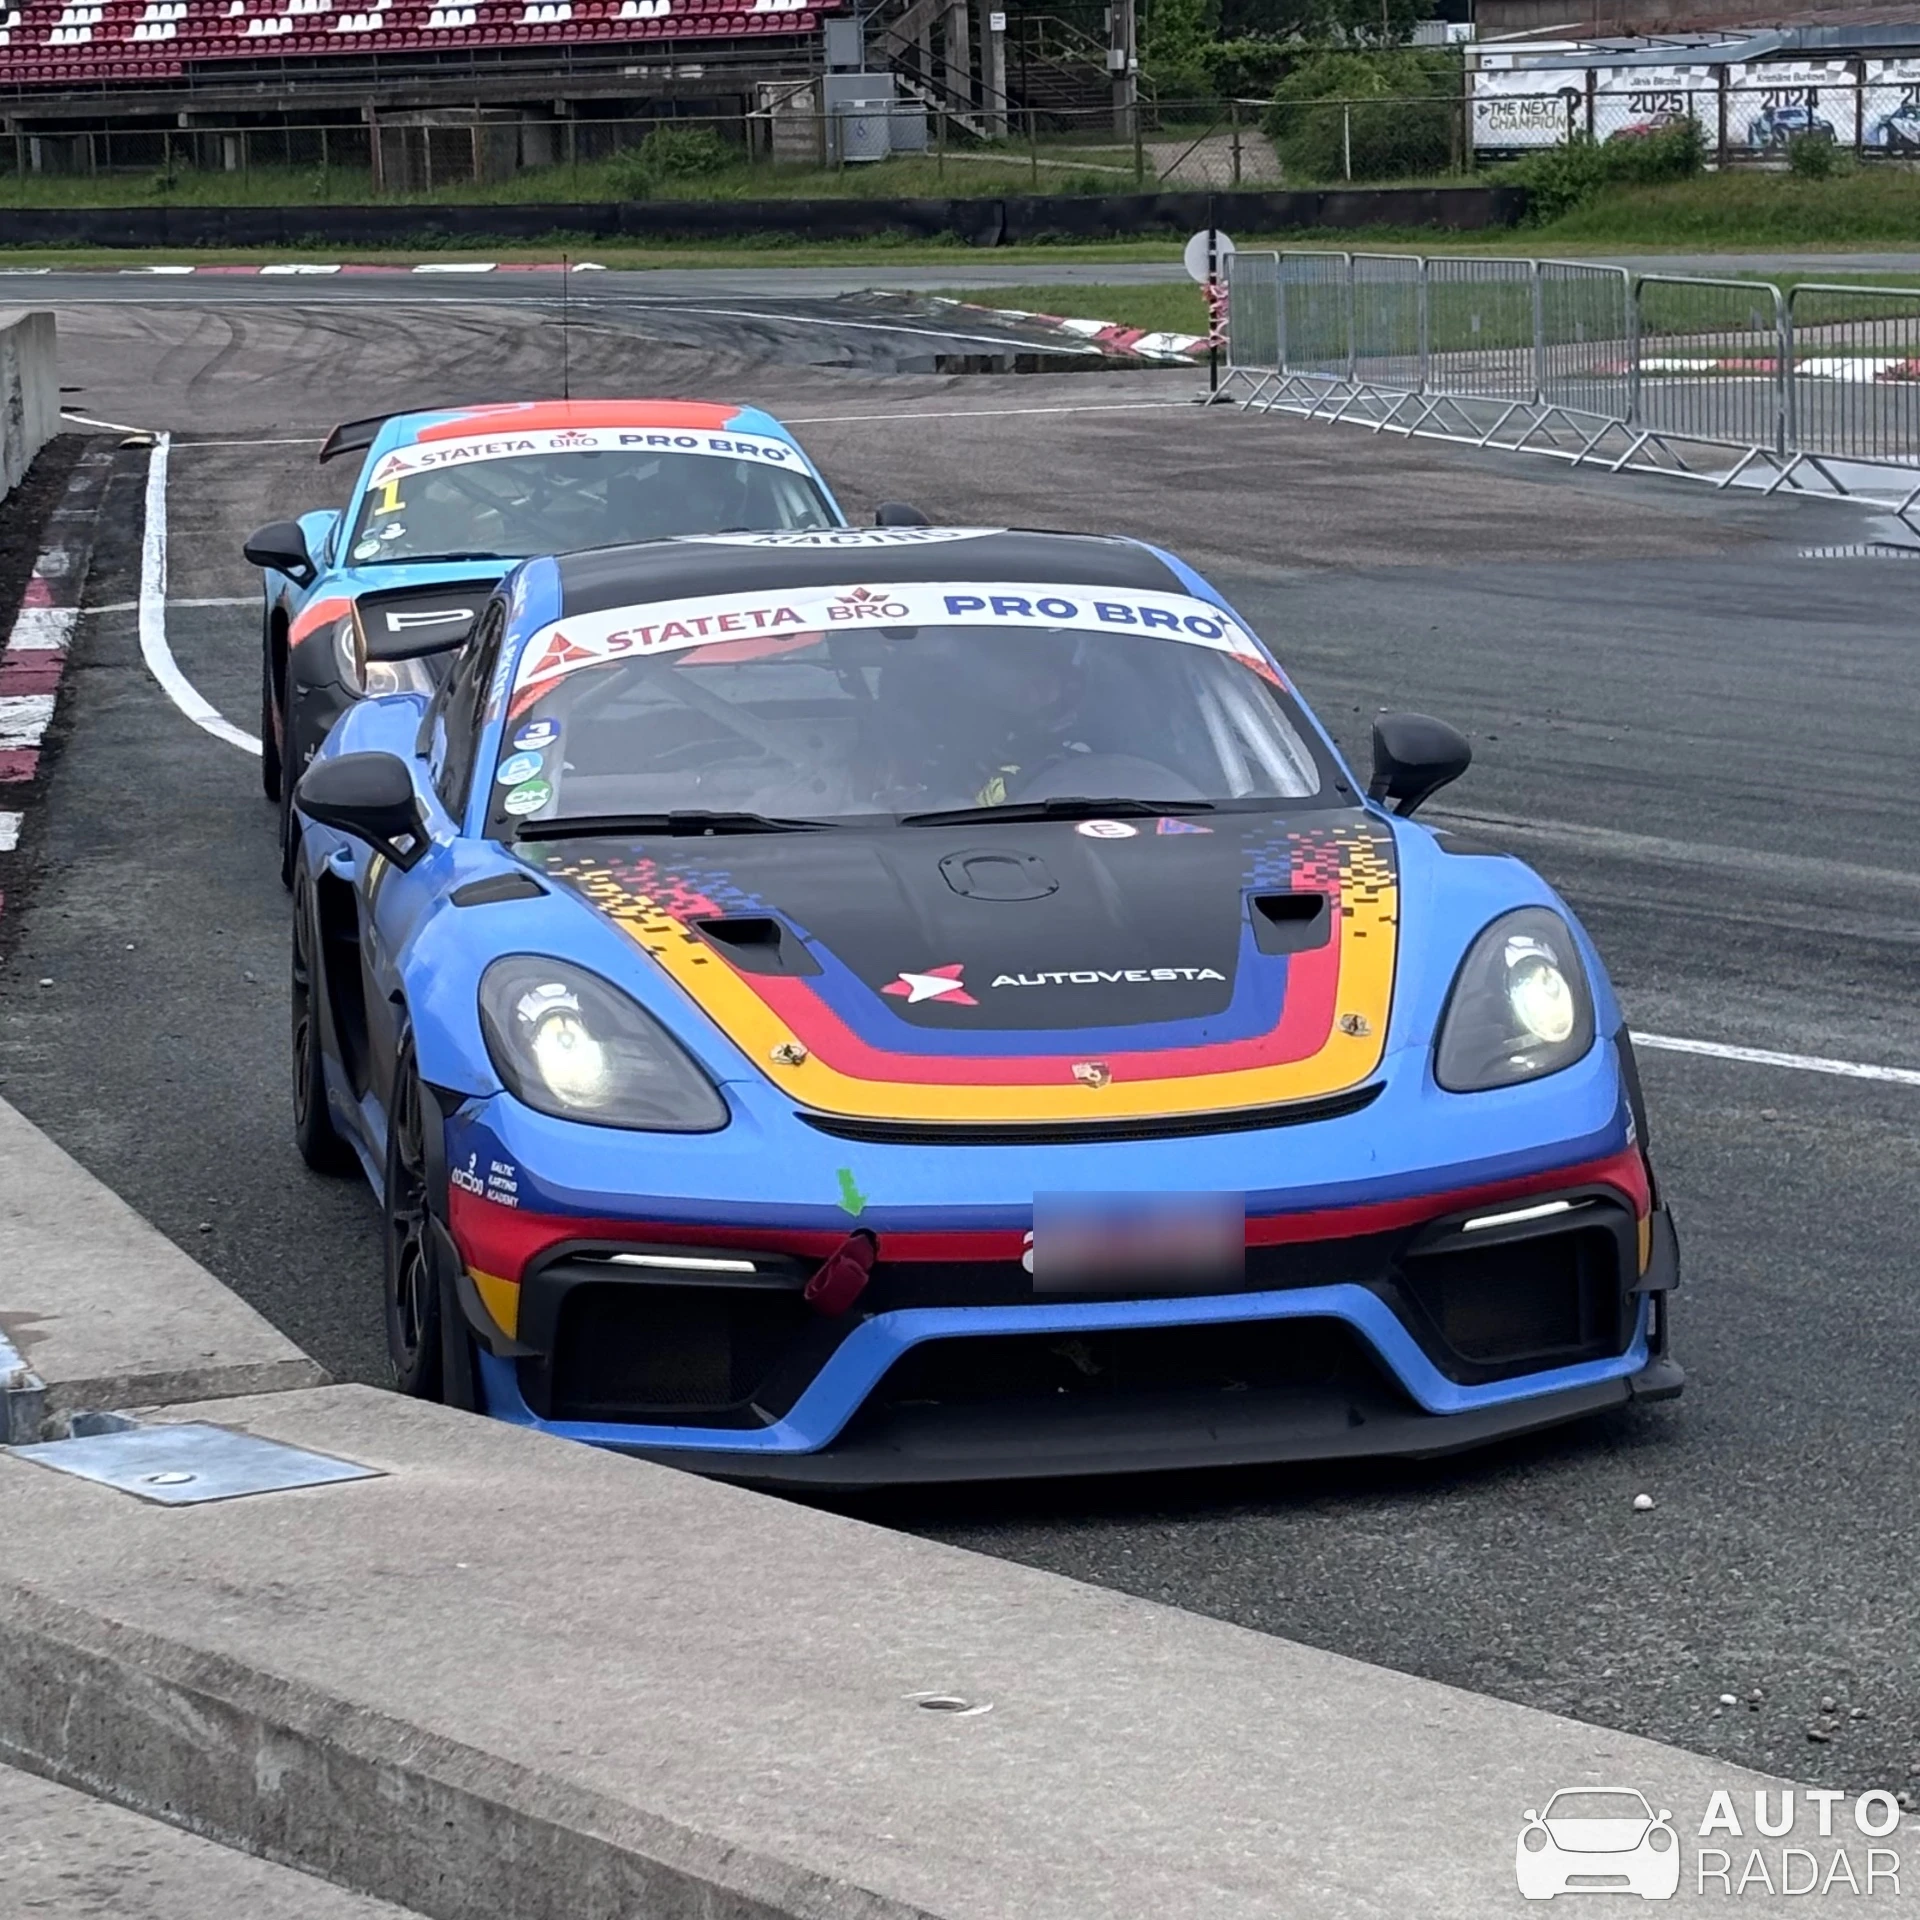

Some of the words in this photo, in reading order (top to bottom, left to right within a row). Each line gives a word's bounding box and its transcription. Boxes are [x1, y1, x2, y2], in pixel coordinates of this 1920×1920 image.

[1489, 102, 1518, 116] THE
[1520, 101, 1560, 115] NEXT
[1628, 93, 1683, 114] 2025
[1489, 116, 1567, 130] CHAMPION
[421, 440, 536, 467] STATETA
[549, 437, 599, 448] BRO
[619, 434, 698, 448] PRO
[708, 438, 786, 461] BRO
[374, 479, 406, 516] 1
[606, 607, 805, 652] STATETA
[826, 603, 909, 621] BRO
[943, 596, 1079, 619] PRO
[1093, 602, 1224, 640] BRO
[512, 788, 549, 802] OK
[991, 968, 1226, 988] AUTOVESTA
